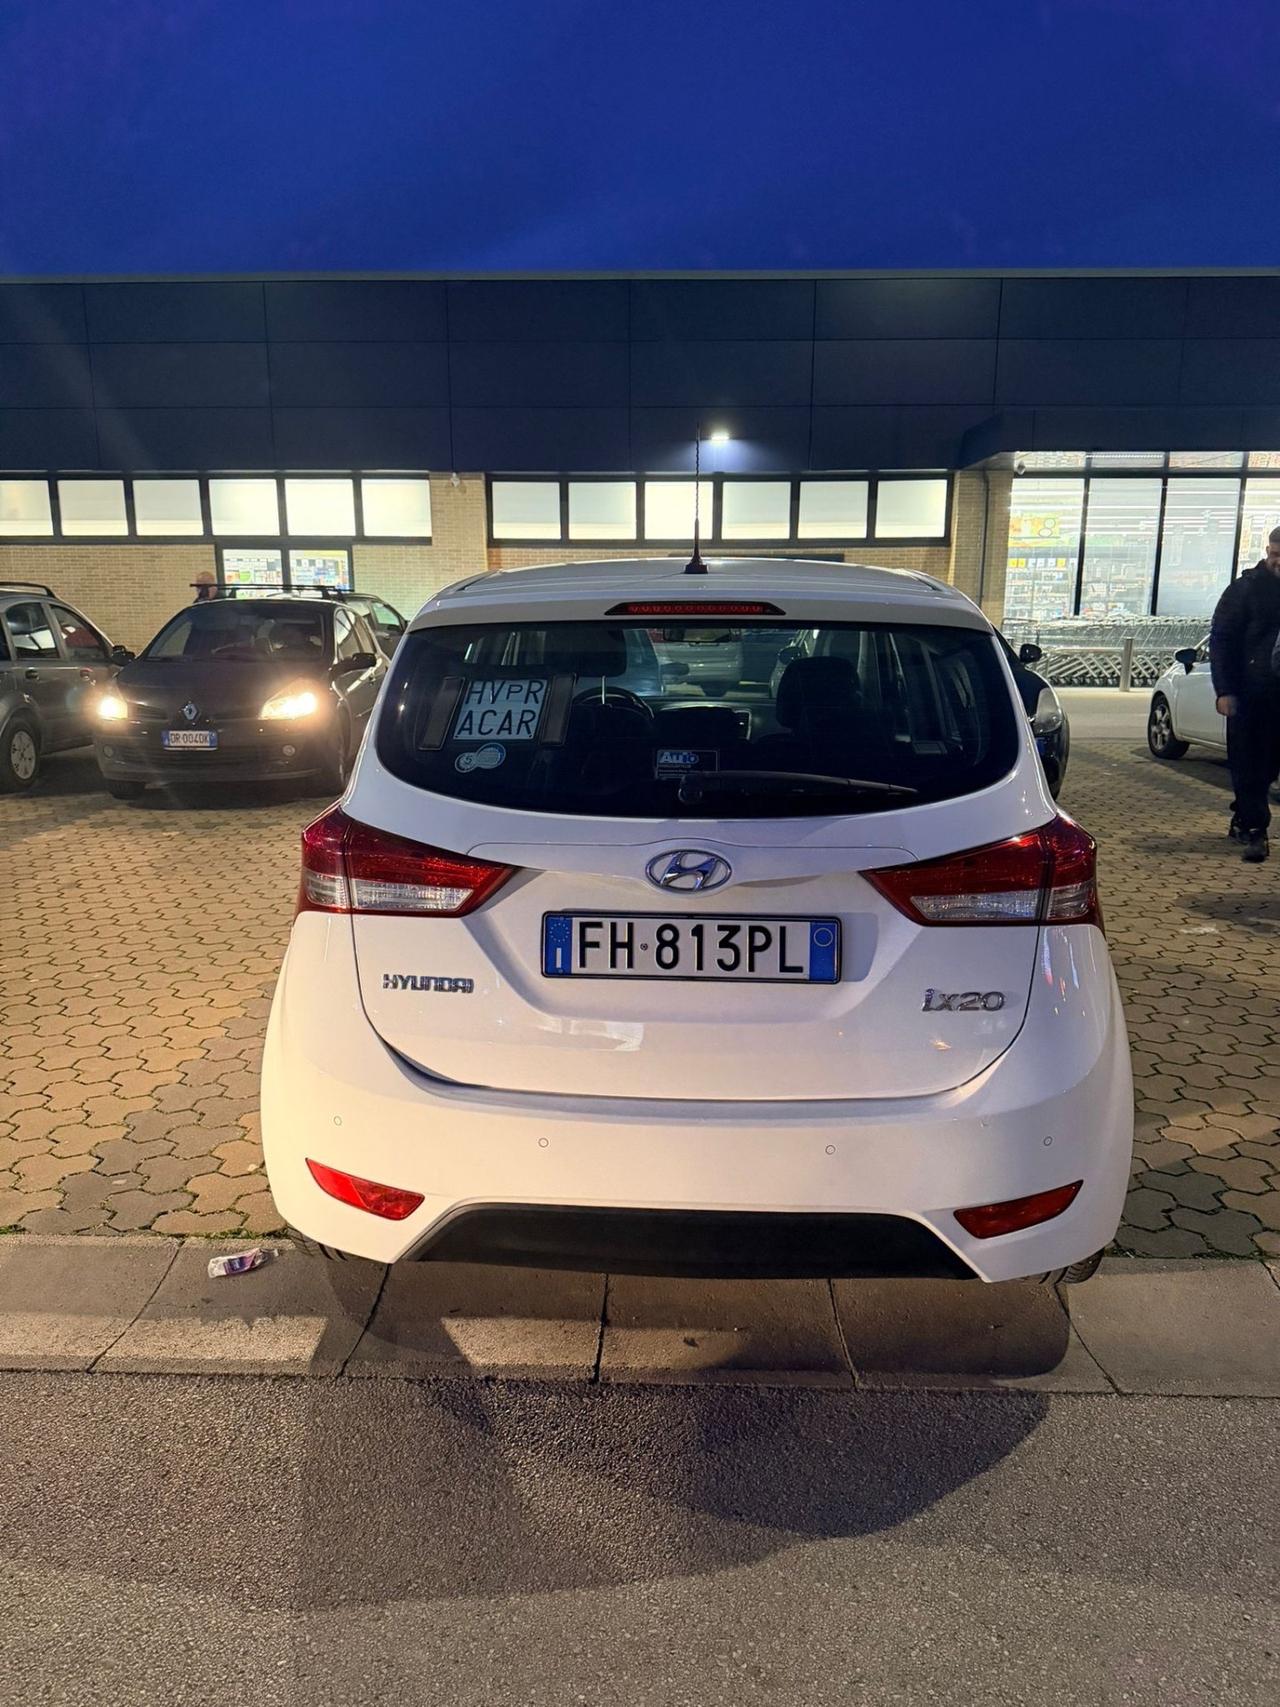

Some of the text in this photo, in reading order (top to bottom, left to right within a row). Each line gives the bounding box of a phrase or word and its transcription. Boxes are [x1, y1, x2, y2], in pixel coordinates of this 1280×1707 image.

[457, 709, 536, 735] ACAR
[578, 921, 804, 974] FH 813PL
[383, 974, 474, 993] HYUNDAI
